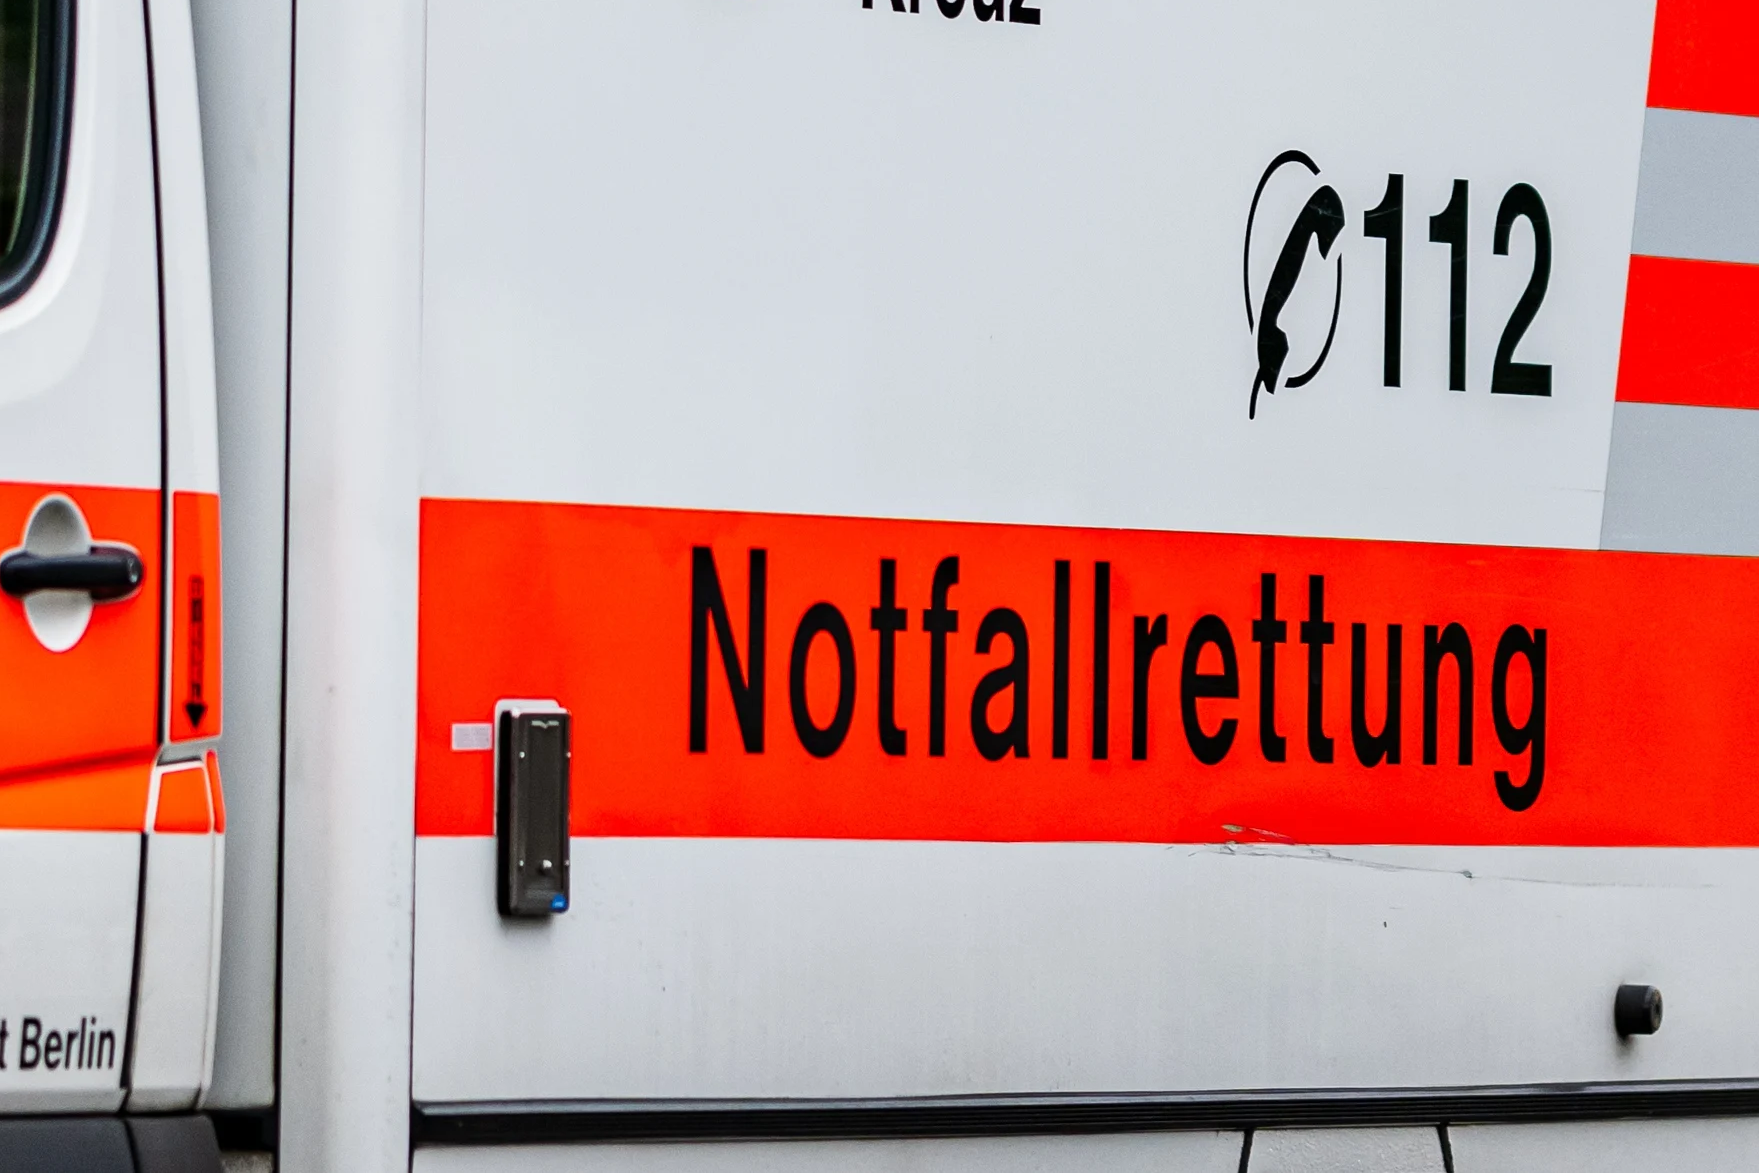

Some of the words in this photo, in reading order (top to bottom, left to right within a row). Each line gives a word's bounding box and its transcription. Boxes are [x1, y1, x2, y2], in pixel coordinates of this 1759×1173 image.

[1363, 173, 1553, 397] 112
[687, 545, 1549, 813] Notfallrettung
[19, 1015, 116, 1071] Berlin
